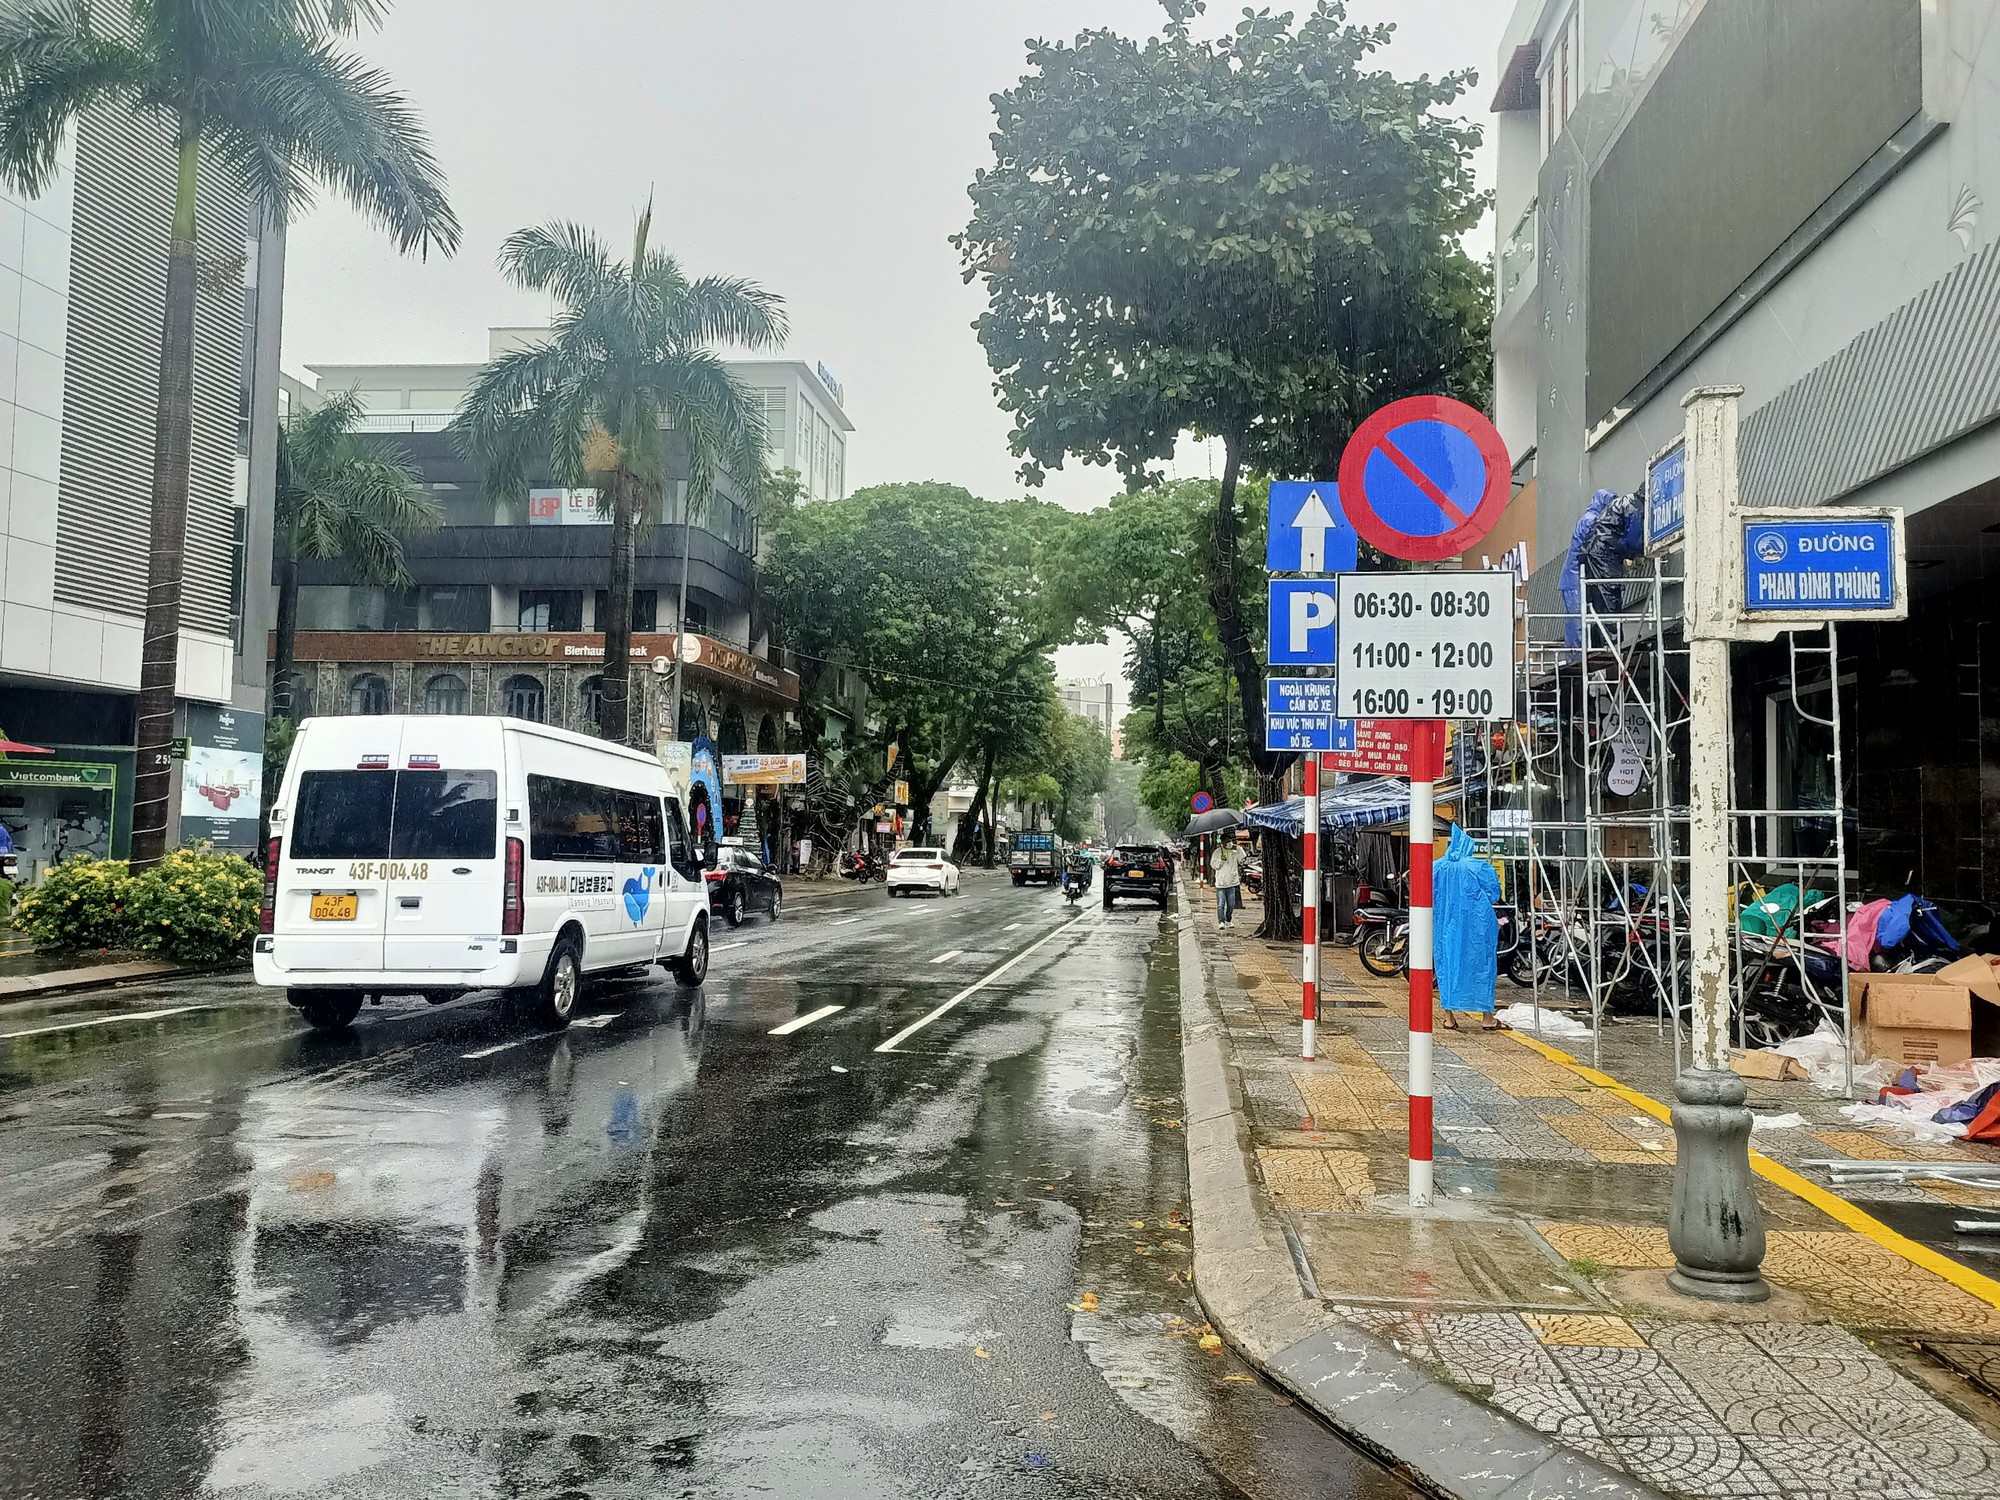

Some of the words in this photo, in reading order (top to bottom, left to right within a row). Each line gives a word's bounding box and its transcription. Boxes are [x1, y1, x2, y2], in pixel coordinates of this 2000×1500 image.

[1798, 531, 1875, 553] ĐƯỜNG
[1759, 572, 1796, 600] PHAN
[1799, 566, 1831, 600] ĐÌNH
[1834, 566, 1880, 599] PHÙNG
[1430, 590, 1490, 617] 08:30
[1289, 591, 1336, 652] P
[629, 647, 648, 656] eak
[1352, 641, 1410, 668] 11:00
[1431, 641, 1493, 668] 12:00
[1279, 681, 1302, 697] NGOÀI
[1289, 697, 1306, 711] CẤM
[1321, 699, 1331, 711] XE
[1352, 688, 1409, 715] 16:00
[1431, 688, 1493, 715] 19:00
[1270, 717, 1285, 730] KHU
[1301, 717, 1314, 730] THU
[1316, 715, 1328, 730] PHÍ
[10, 771, 82, 782] Vietcombank
[349, 863, 428, 880] 43F-004.48
[324, 897, 343, 907] 43F
[315, 908, 350, 918] 004.48
